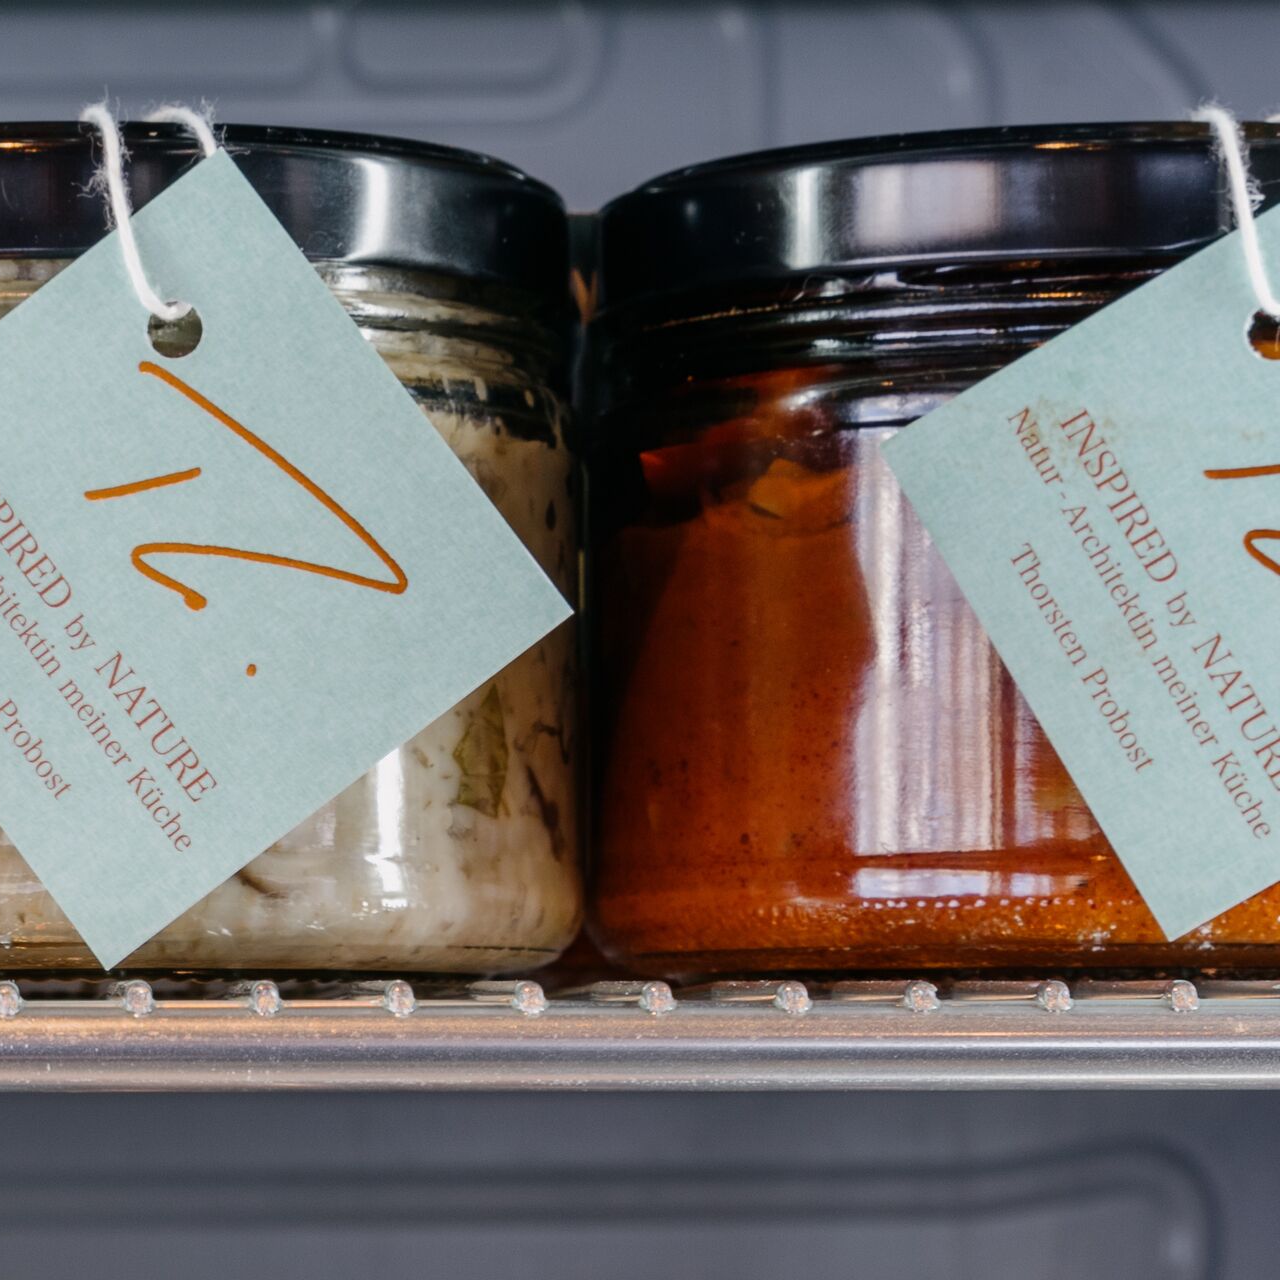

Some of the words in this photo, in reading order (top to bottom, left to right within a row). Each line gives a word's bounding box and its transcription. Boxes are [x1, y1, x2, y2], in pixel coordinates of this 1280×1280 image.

[1008, 407, 1063, 485] Natur
[1060, 504, 1158, 653] Architektin
[1150, 654, 1217, 746] meiner
[1209, 750, 1270, 838] Küche
[1058, 409, 1179, 585] INSPIRED
[1165, 590, 1199, 627] by
[56, 677, 132, 768] meiner
[126, 766, 192, 852] Küche
[63, 613, 96, 651] by
[94, 651, 218, 803] NATURE
[1009, 542, 1088, 666] Thorsten
[1079, 666, 1154, 774] Probost
